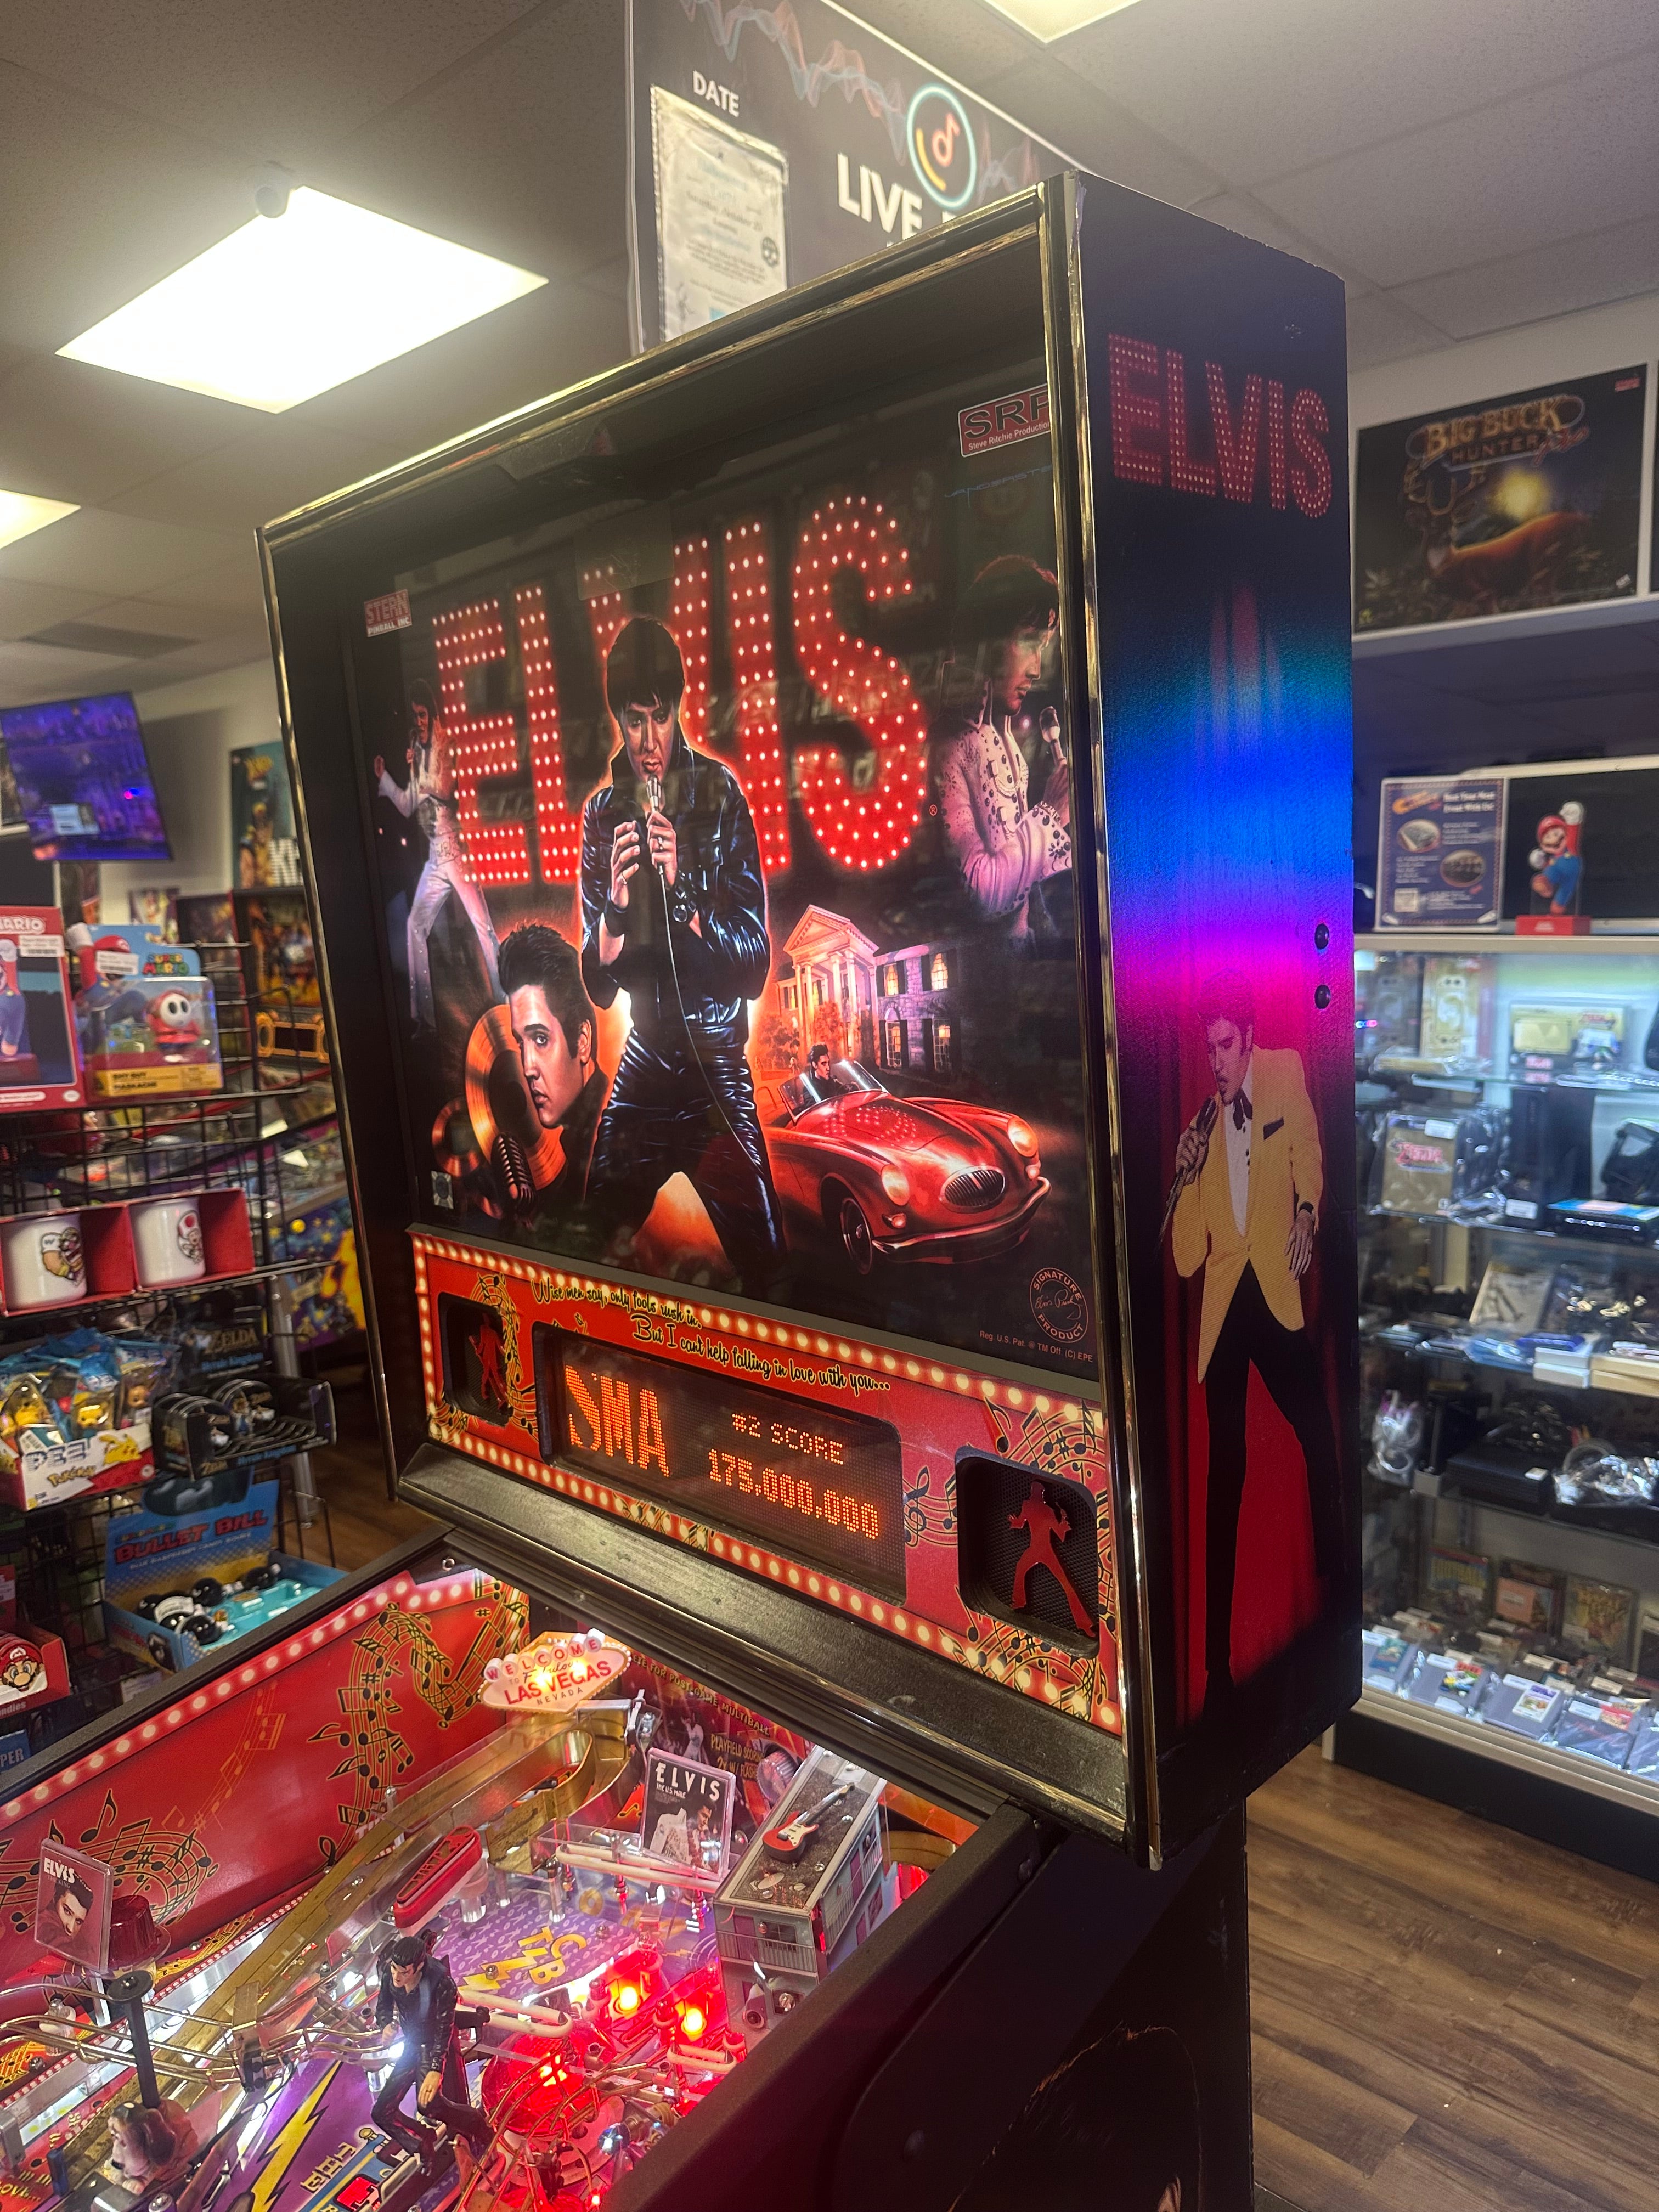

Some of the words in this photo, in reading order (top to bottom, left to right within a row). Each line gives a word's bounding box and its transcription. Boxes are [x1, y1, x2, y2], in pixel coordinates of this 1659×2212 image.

[692, 71, 740, 117] DATE
[837, 153, 923, 240] LIVE
[968, 441, 988, 451] Steve
[989, 432, 1013, 445] Ritchie
[1108, 332, 1332, 518] ELVIS
[1425, 415, 1477, 459] BIG
[1482, 397, 1562, 437] BUCK
[366, 592, 409, 625] STERN
[368, 621, 395, 635] PINBALL
[431, 491, 928, 884] ELVIS
[143, 962, 189, 975] MARIO
[146, 952, 183, 964] SUPER
[1034, 1271, 1082, 1301] SIGNATURE
[531, 1277, 563, 1304] Wise
[566, 1287, 585, 1299] men
[587, 1288, 607, 1308] say,
[611, 1287, 631, 1313] only
[633, 1290, 657, 1314] fools
[660, 1302, 685, 1321] rush
[686, 1308, 702, 1329] in.
[1037, 1313, 1084, 1340] PRODUCT
[631, 1314, 664, 1344] But
[666, 1323, 678, 1347] I
[706, 1338, 729, 1367] help
[732, 1347, 772, 1380] falling
[772, 1359, 788, 1377] in
[789, 1358, 816, 1385] love
[819, 1364, 847, 1388] with
[848, 1371, 891, 1396] you...
[979, 1330, 995, 1341] Reg.
[997, 1335, 1011, 1344] U.S.
[1013, 1338, 1025, 1347] Pat.
[1037, 1343, 1048, 1353] TM
[1065, 1350, 1076, 1360] (C)
[1077, 1353, 1093, 1363] EPE
[565, 1364, 670, 1478] SMA
[732, 1413, 761, 1438] #2
[771, 1422, 844, 1465] SCORE
[115, 1522, 209, 1564] BULLET
[215, 1509, 268, 1535] BILL
[486, 1638, 599, 1680] WELCOME
[504, 1680, 543, 1705] LAS
[546, 1660, 612, 1692] VEGAS
[509, 1677, 520, 1685] TO
[537, 1686, 584, 1705] NEVADA
[633, 1655, 648, 1668] ETE
[650, 1663, 667, 1678] FOR
[669, 1674, 718, 1707] POST-GAME
[721, 1703, 771, 1736] MULTIBALL
[0, 1701, 26, 1717] ndies
[0, 1748, 24, 1768] PER
[711, 1733, 742, 1757] PLAYFIELD
[656, 1762, 720, 1801] ELVIS
[656, 1782, 665, 1792] THE
[674, 1789, 686, 1799] MALE
[44, 1857, 75, 1883] ELVIS
[58, 1878, 70, 1889] KING
[518, 1926, 587, 1985] TCB
[0, 2182, 42, 2202] OVE...
